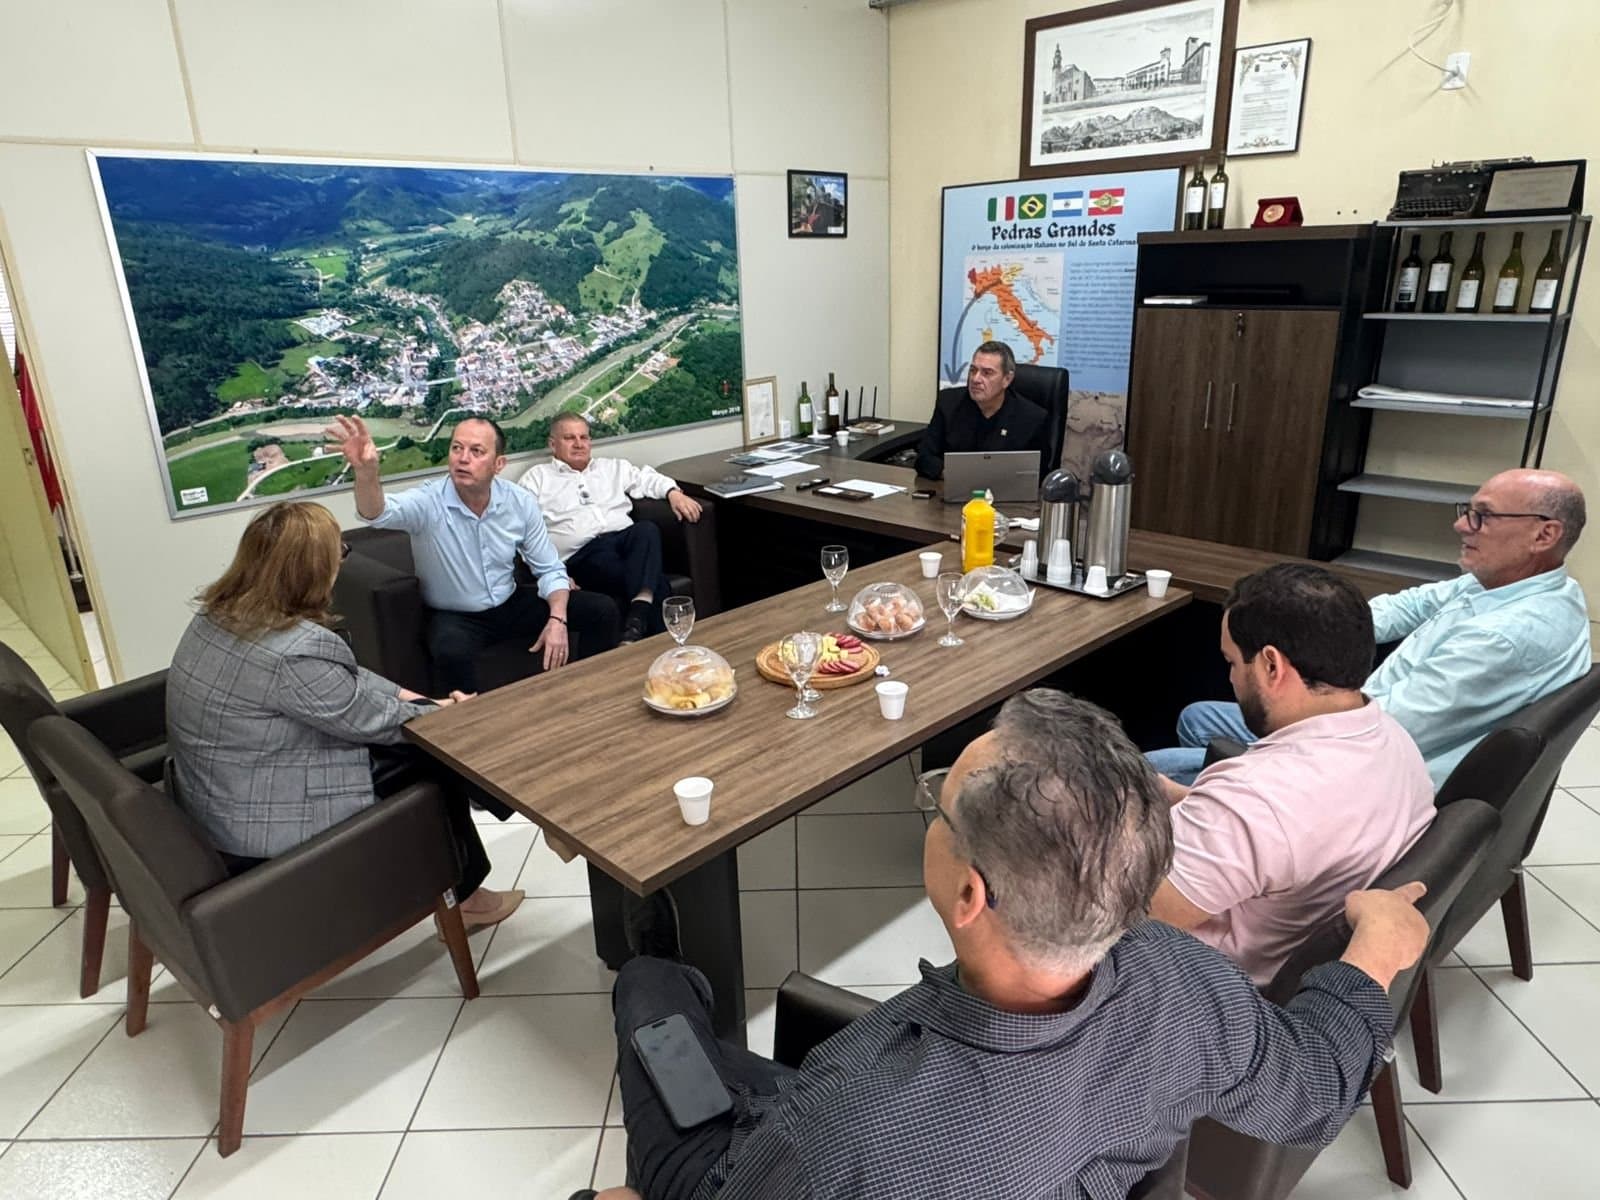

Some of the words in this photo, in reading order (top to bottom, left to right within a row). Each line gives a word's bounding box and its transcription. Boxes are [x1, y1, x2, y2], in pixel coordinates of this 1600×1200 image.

[992, 223, 1042, 240] Pedras
[1047, 219, 1116, 238] Grandes
[1087, 239, 1106, 247] Santa
